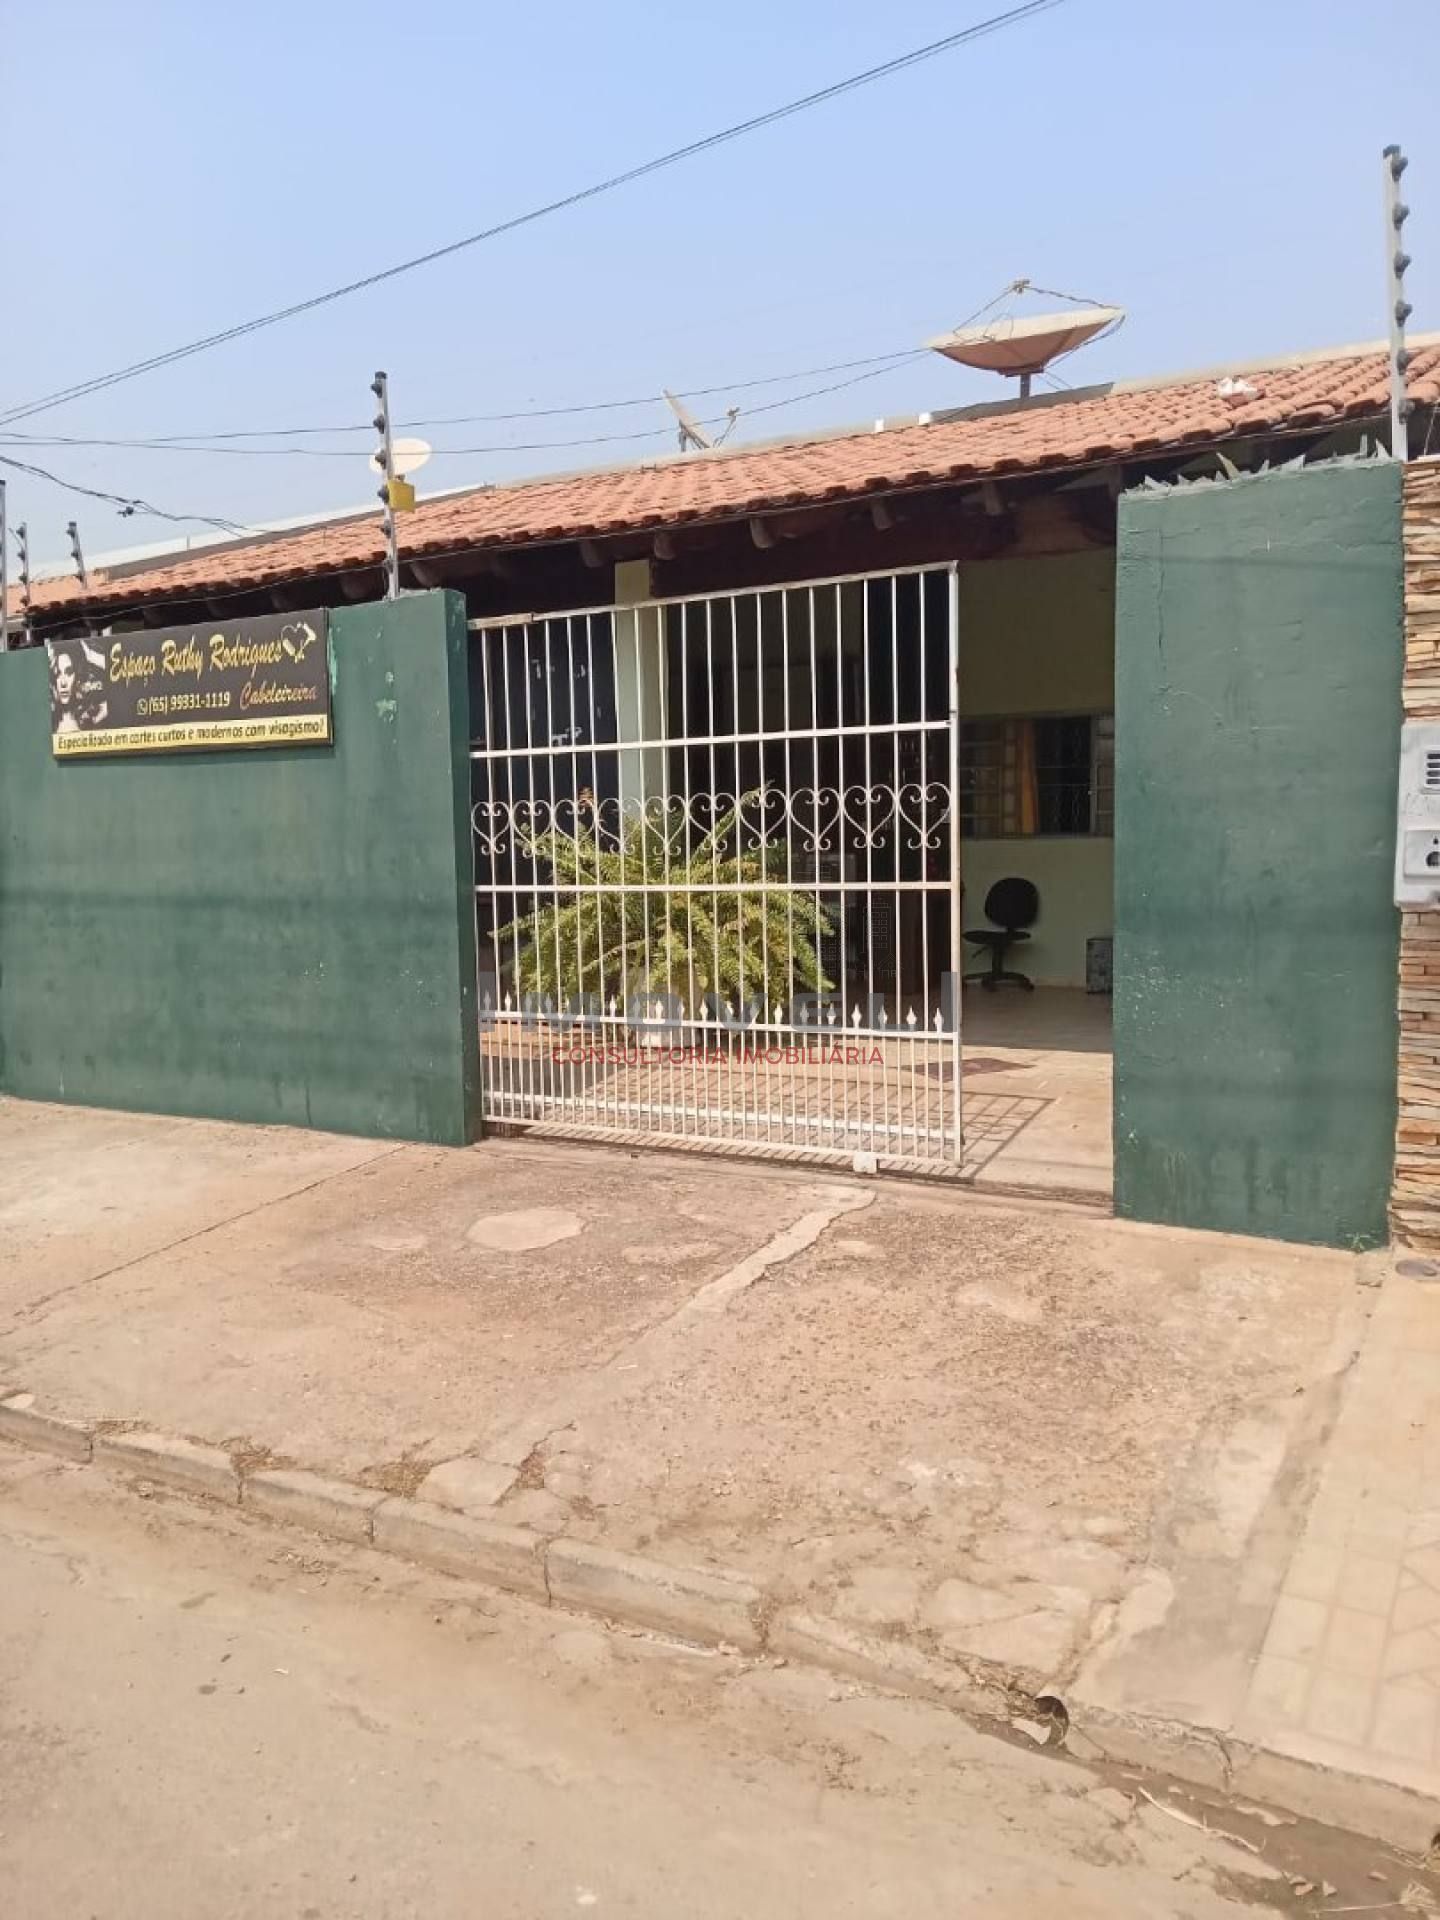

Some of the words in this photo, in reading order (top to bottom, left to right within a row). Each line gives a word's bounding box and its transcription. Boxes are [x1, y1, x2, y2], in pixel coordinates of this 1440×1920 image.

[110, 642, 156, 688] Espaço
[161, 634, 204, 681] Ruthy
[209, 633, 284, 679] Rodrigues
[149, 695, 168, 715] (65)
[239, 680, 317, 711] Cabeleireira
[114, 734, 128, 745] em
[158, 729, 186, 742] curtos
[188, 729, 194, 740] e
[197, 724, 243, 738] modernos
[245, 725, 266, 737] com
